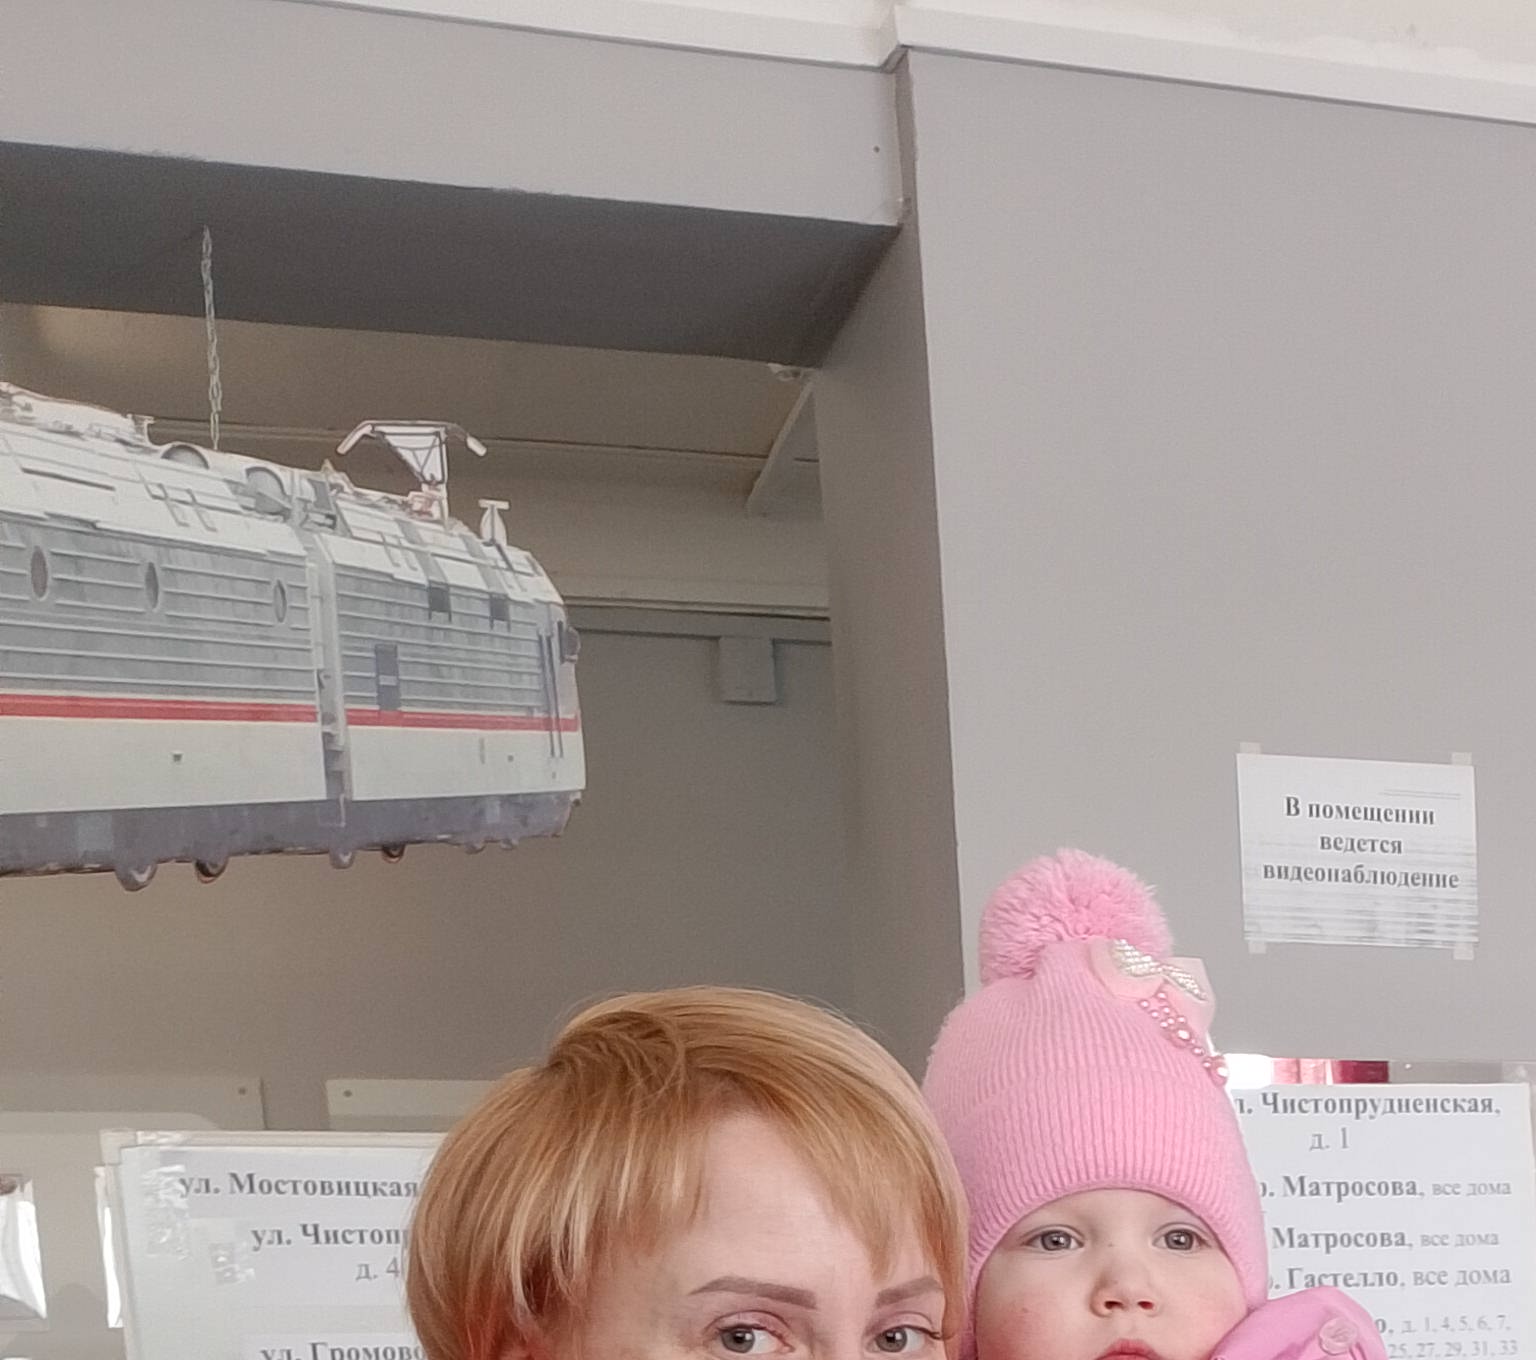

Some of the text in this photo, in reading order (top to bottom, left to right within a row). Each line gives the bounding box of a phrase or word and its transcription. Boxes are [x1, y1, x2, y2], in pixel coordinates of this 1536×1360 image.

[1285, 796, 1435, 826] В помещении
[1319, 834, 1403, 855] ведется
[1262, 863, 1460, 889] видеонаблюдение
[1309, 1127, 1349, 1152] д. 1
[178, 1176, 221, 1198] ул.
[1281, 1175, 1425, 1203] Матросова,
[1431, 1182, 1462, 1197] все
[1466, 1181, 1512, 1198] дома
[251, 1228, 292, 1252] ул.
[1271, 1226, 1499, 1255] Матросова, все дома
[356, 1260, 379, 1280] д.
[1413, 1269, 1449, 1287] все
[1455, 1267, 1512, 1287] дома
[1441, 1316, 1456, 1333] 4,
[1459, 1315, 1474, 1332] 5,
[1477, 1314, 1493, 1332] 6,
[1497, 1314, 1512, 1331] 7,
[1499, 1339, 1519, 1356] 33
